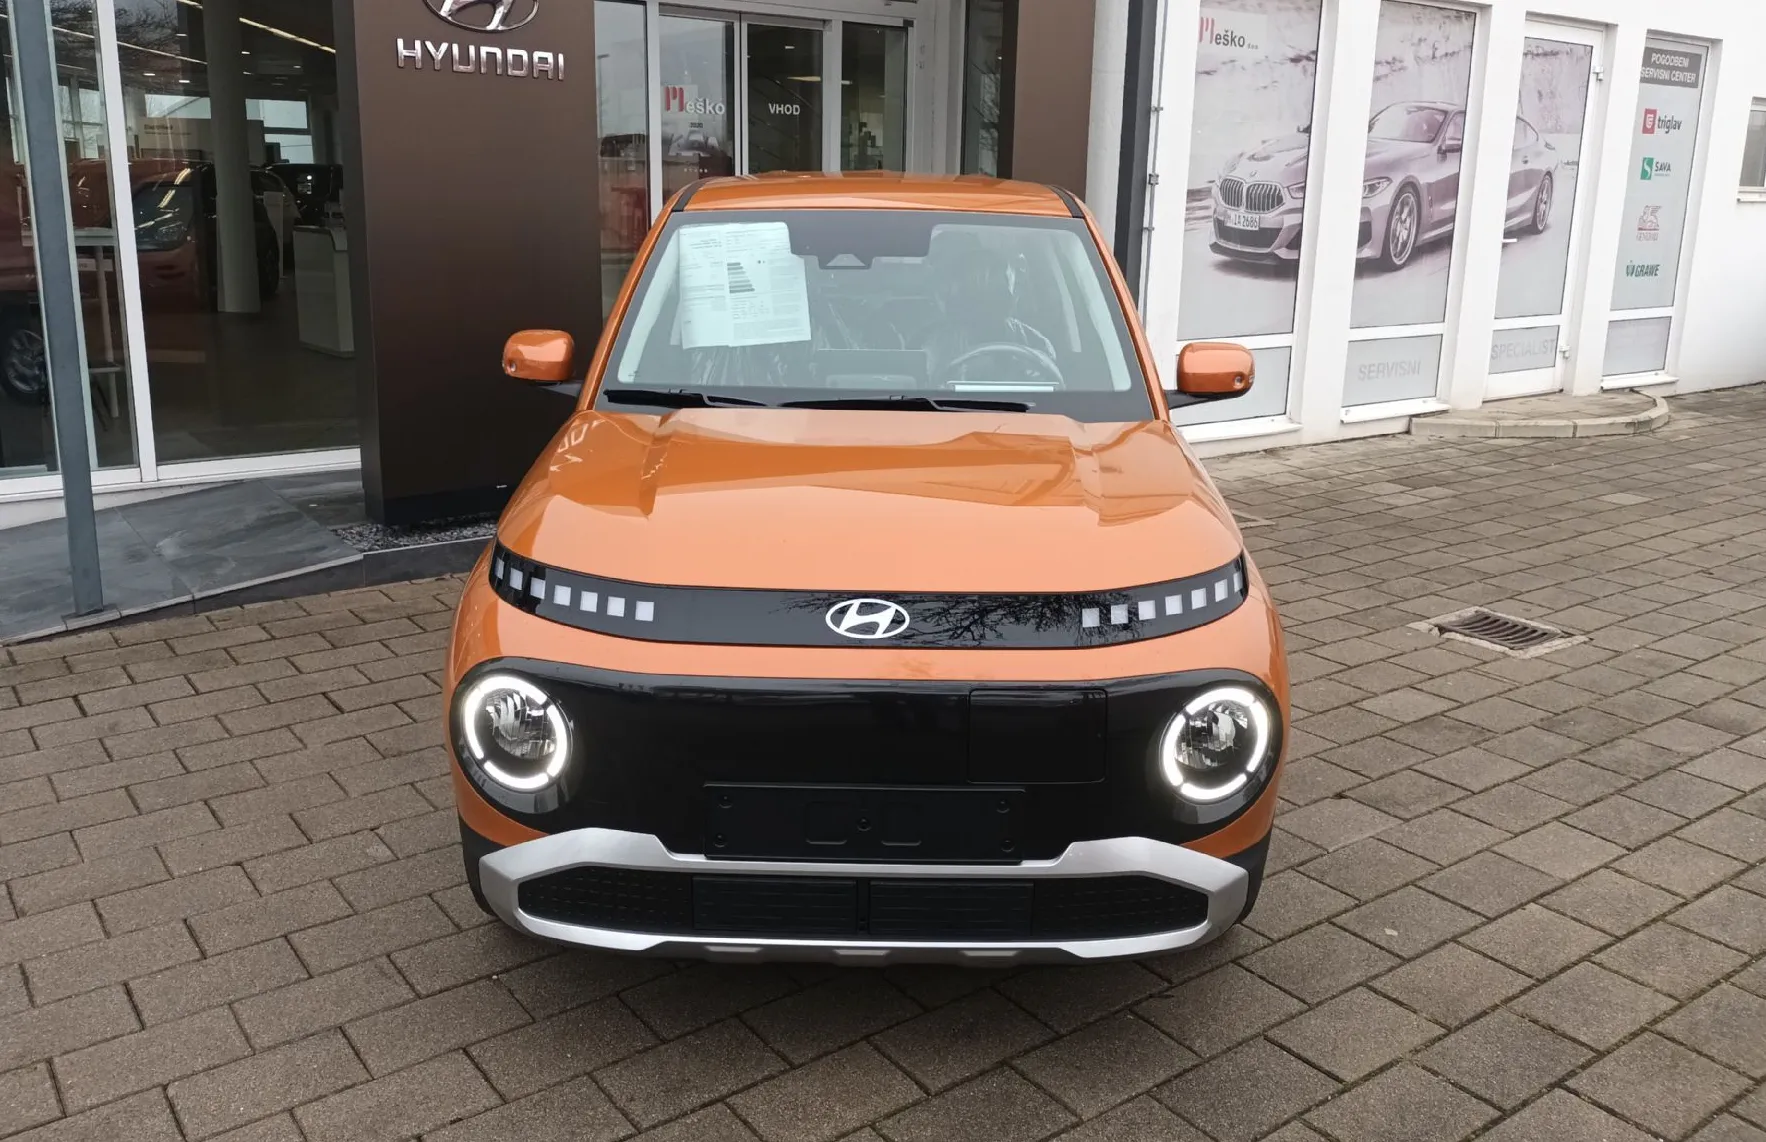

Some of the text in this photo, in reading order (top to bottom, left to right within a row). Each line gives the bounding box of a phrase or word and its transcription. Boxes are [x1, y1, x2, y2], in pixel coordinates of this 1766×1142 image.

[396, 38, 564, 80] HYUNDAI
[1651, 53, 1690, 68] POGODBENI
[1640, 67, 1696, 83] SERVISNI CENTER
[768, 102, 801, 116] VHOD
[1657, 114, 1682, 134] triglav
[1655, 161, 1671, 172] SAVA
[1242, 215, 1258, 229] 2686
[1635, 264, 1661, 277] GRAWE
[1491, 338, 1556, 360] SPECIALIST
[1358, 361, 1421, 381] SERVISNI
